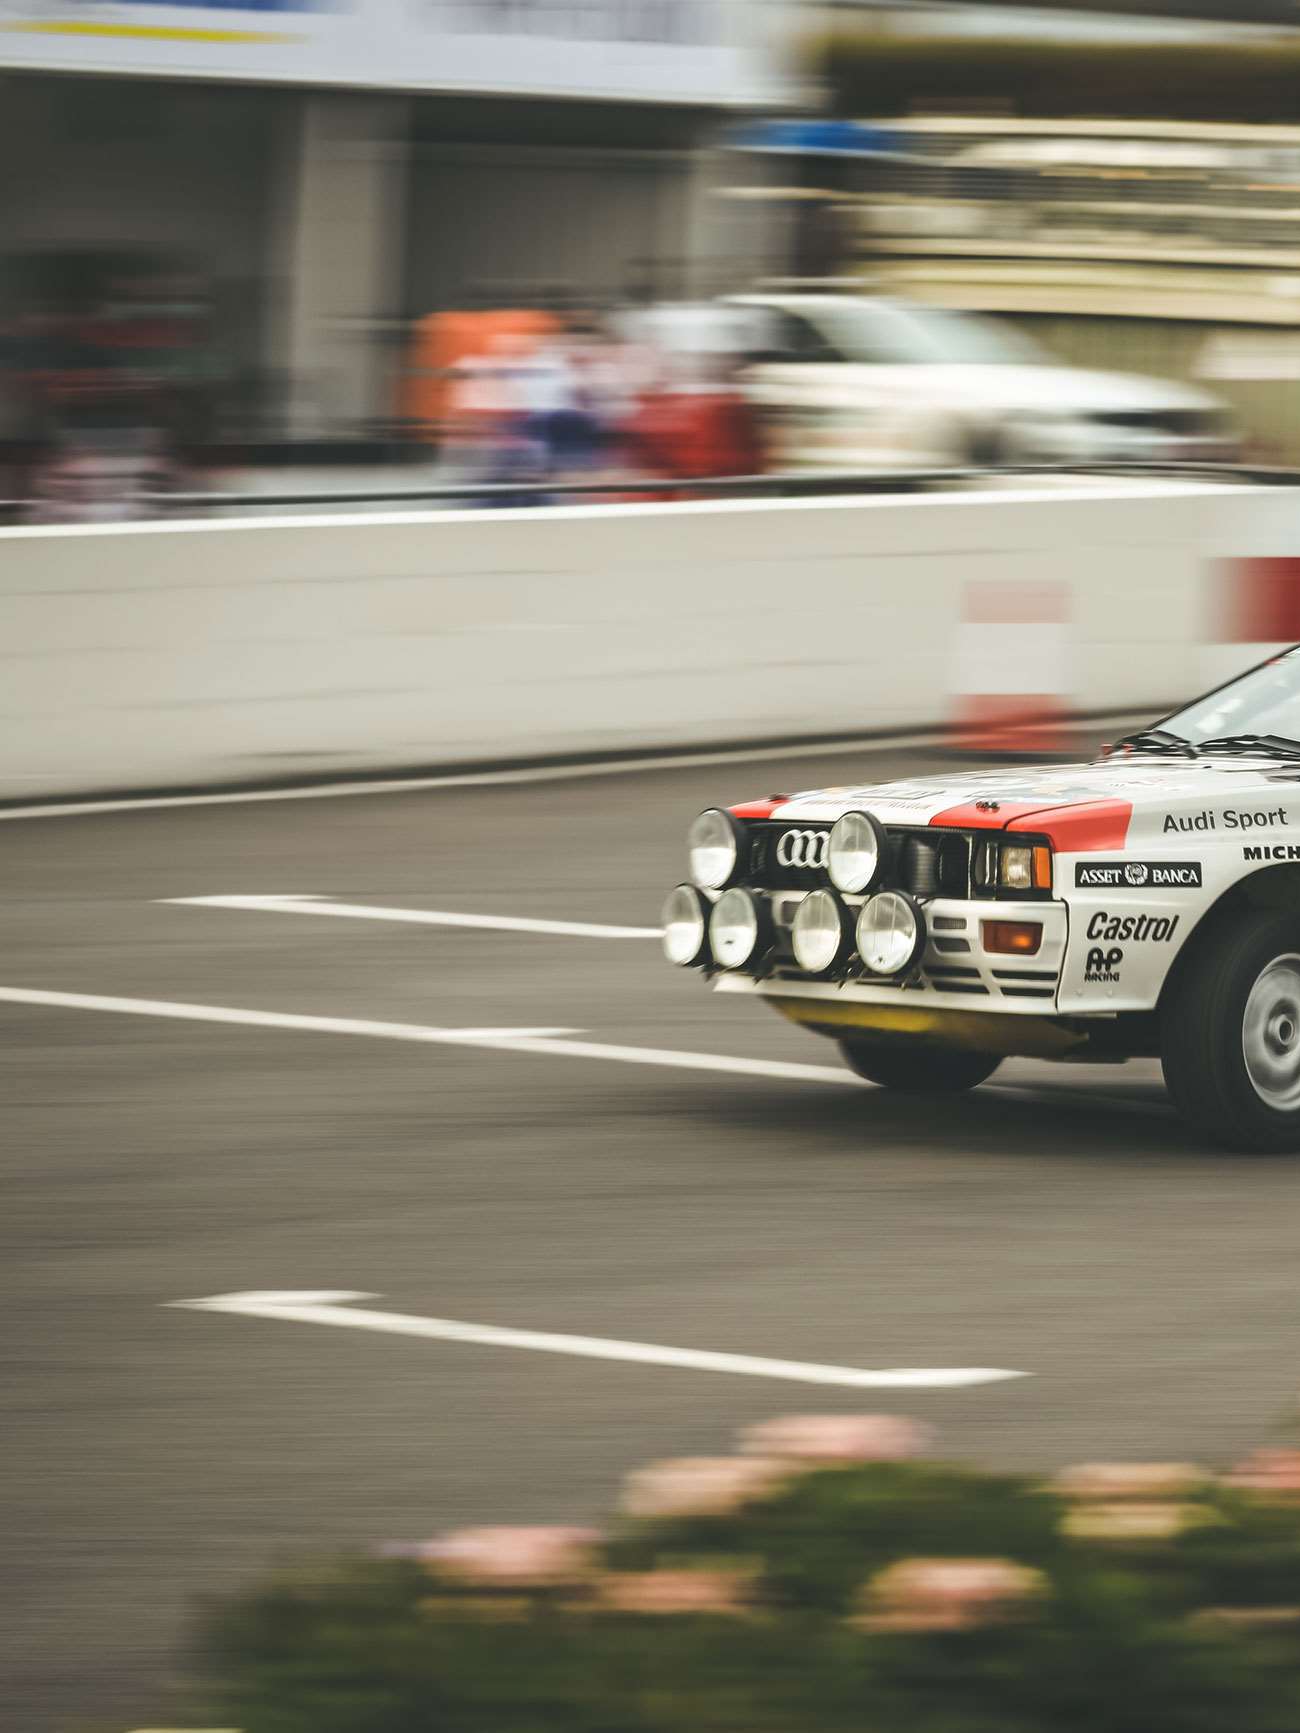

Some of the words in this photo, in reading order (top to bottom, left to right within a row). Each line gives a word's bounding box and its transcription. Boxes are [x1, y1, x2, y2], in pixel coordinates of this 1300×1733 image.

[1163, 811, 1215, 833] Audi
[1224, 807, 1289, 832] Sport
[1079, 869, 1122, 885] ASSET
[1152, 869, 1199, 885] BANCA
[1086, 911, 1180, 942] Castrol
[1086, 947, 1123, 971] AP
